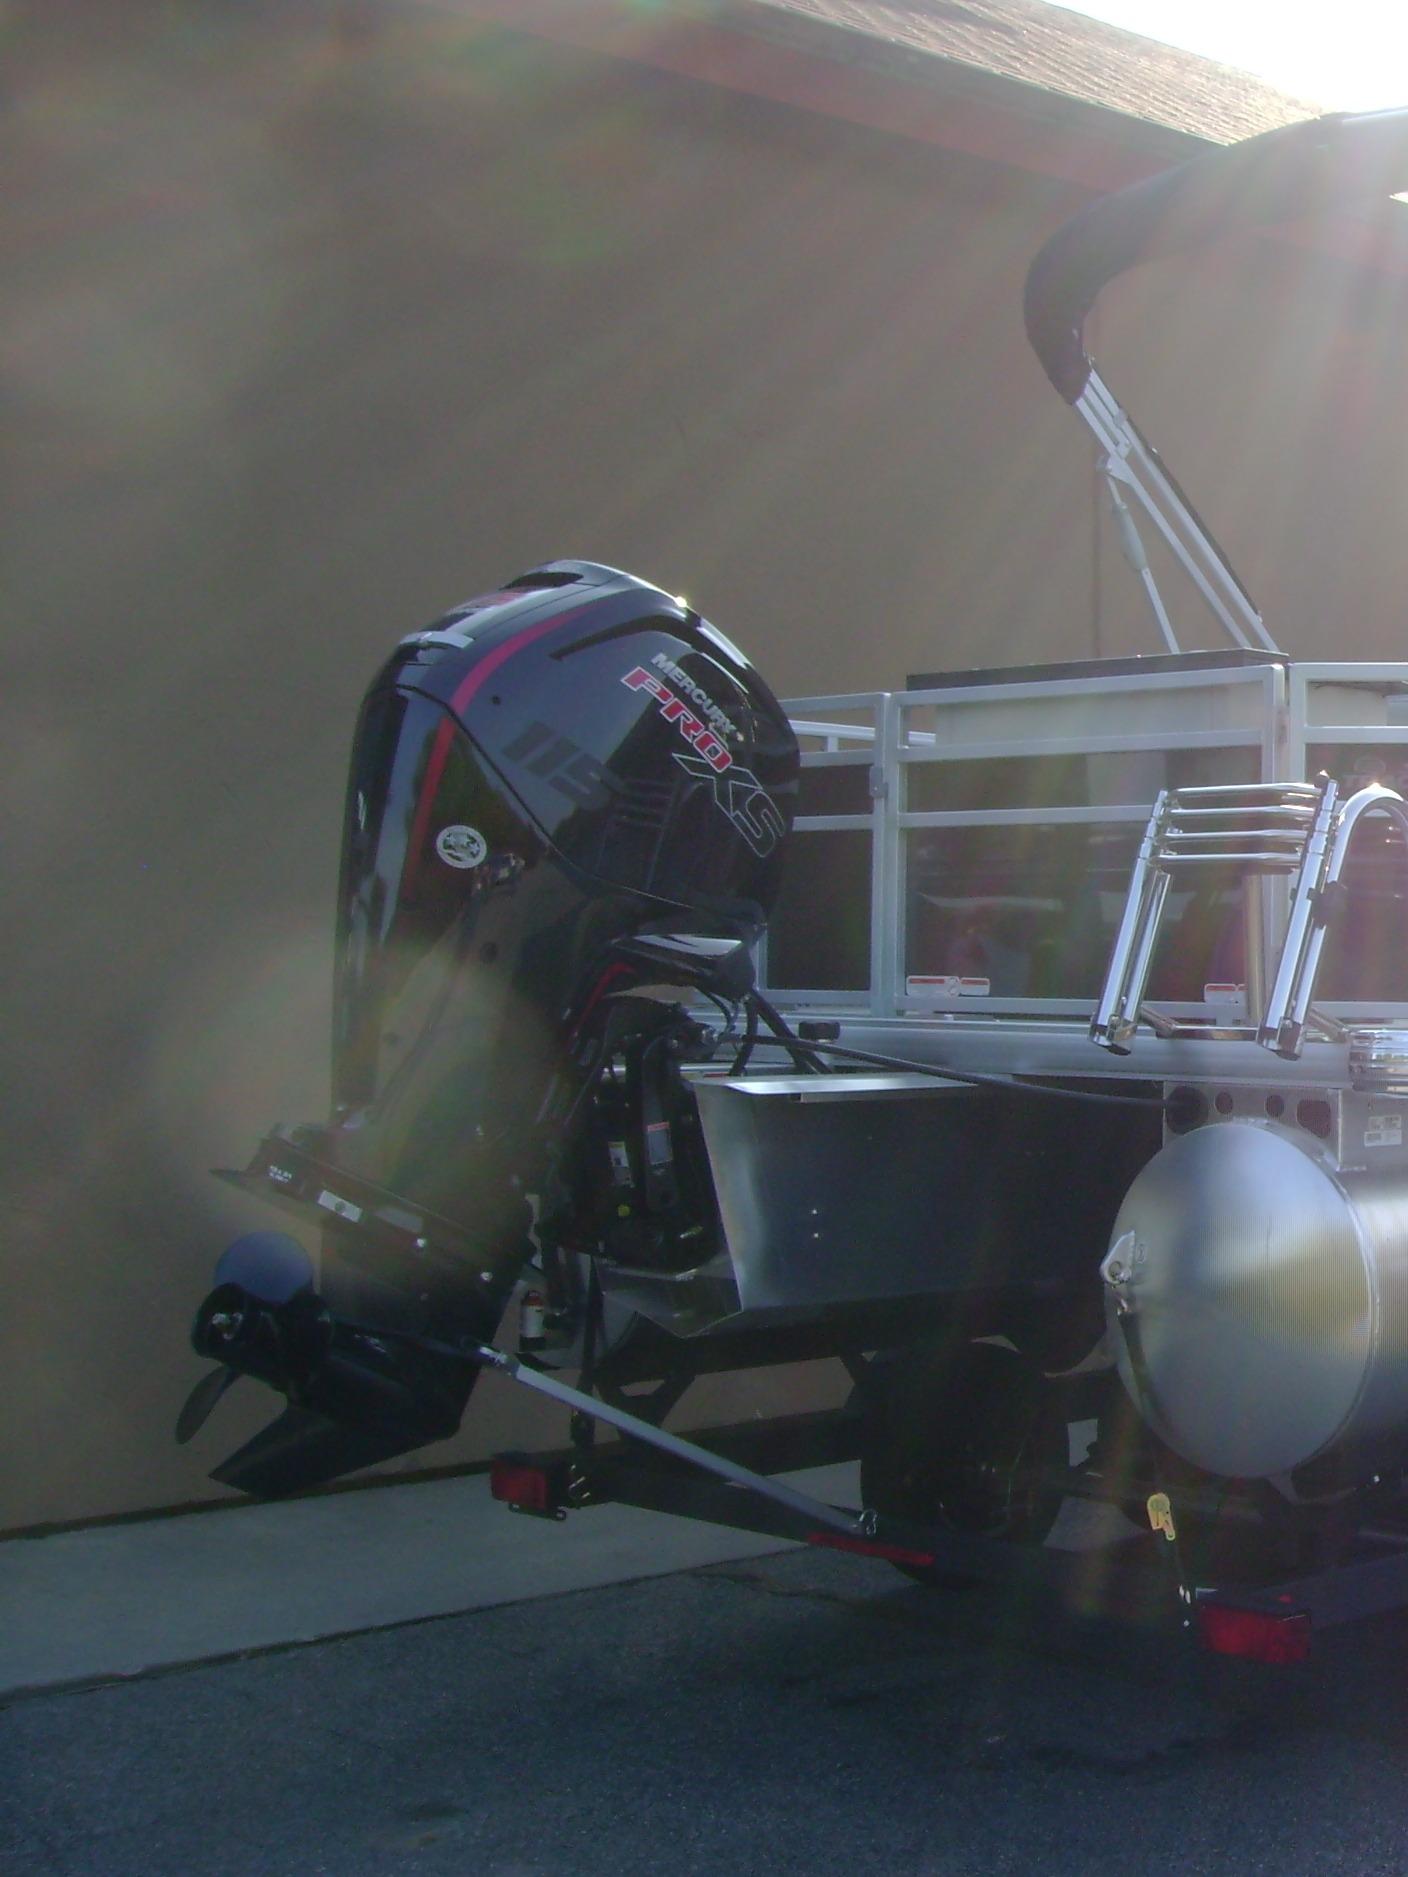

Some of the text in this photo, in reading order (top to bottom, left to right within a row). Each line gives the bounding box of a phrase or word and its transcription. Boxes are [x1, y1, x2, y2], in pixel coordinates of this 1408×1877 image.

[651, 652, 738, 734] MERCURY
[620, 666, 785, 858] PRO XS
